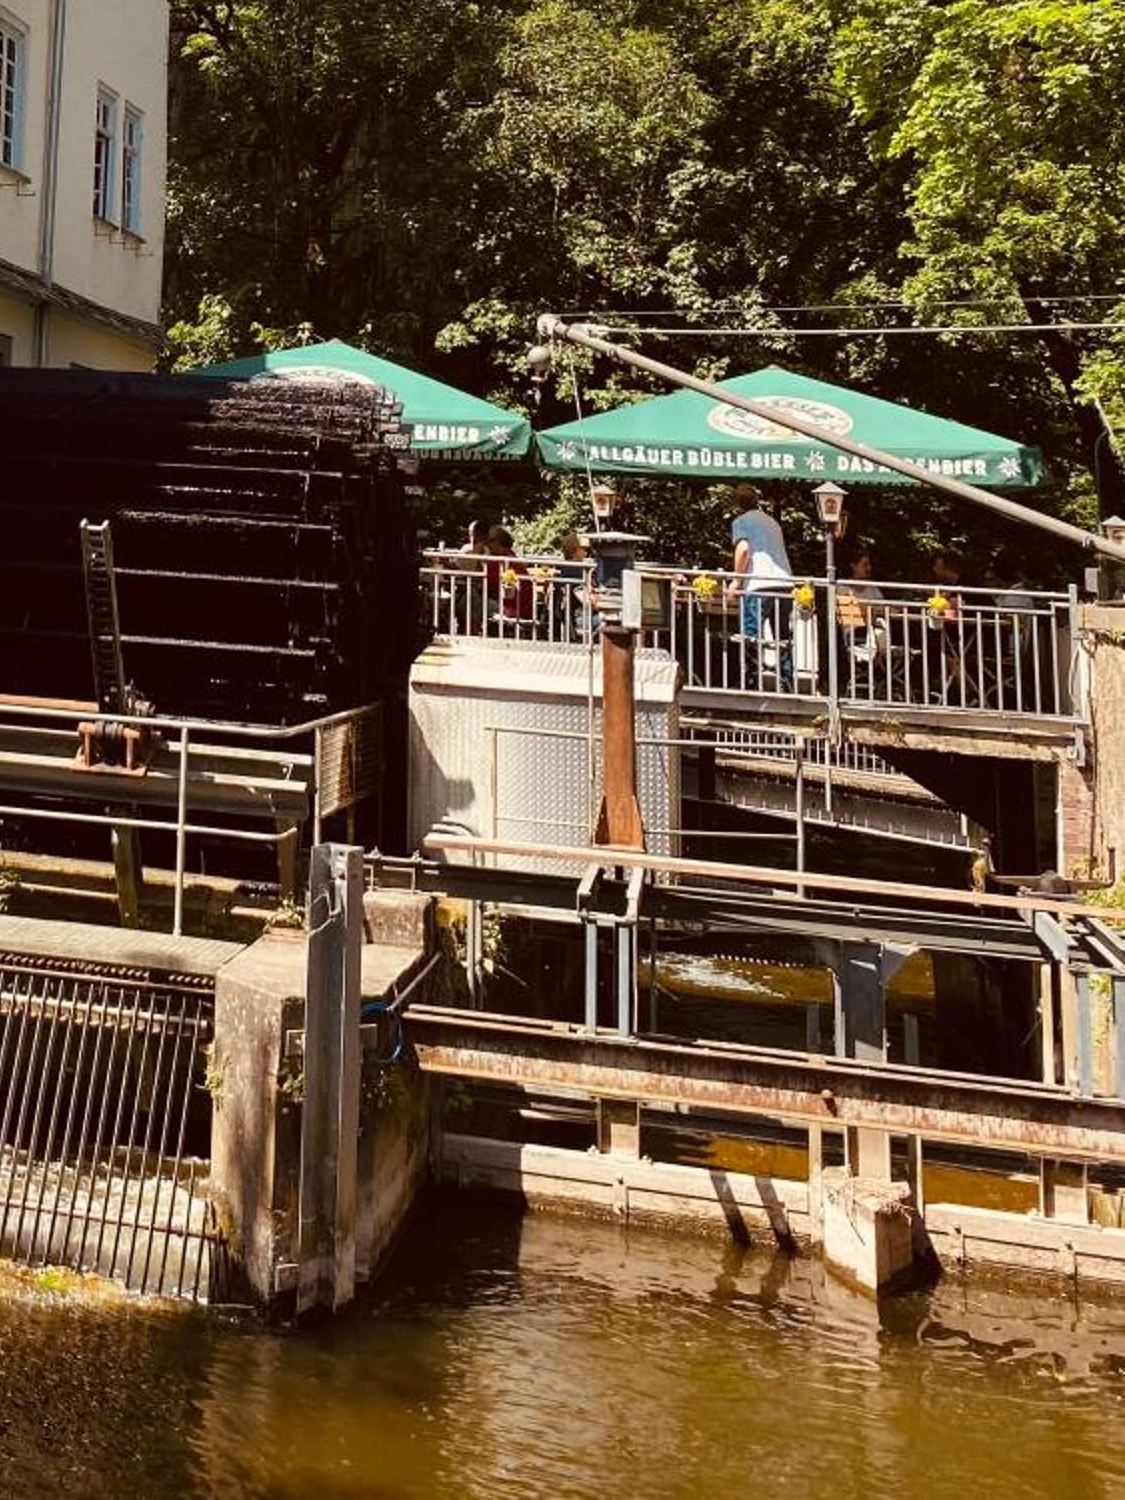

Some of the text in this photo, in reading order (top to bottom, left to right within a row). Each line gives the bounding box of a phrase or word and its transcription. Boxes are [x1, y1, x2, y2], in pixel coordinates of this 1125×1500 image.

[414, 424, 480, 443] ENBIER
[588, 445, 796, 470] ALLGÄUER BÜBLE BIER
[837, 455, 874, 473] DAS
